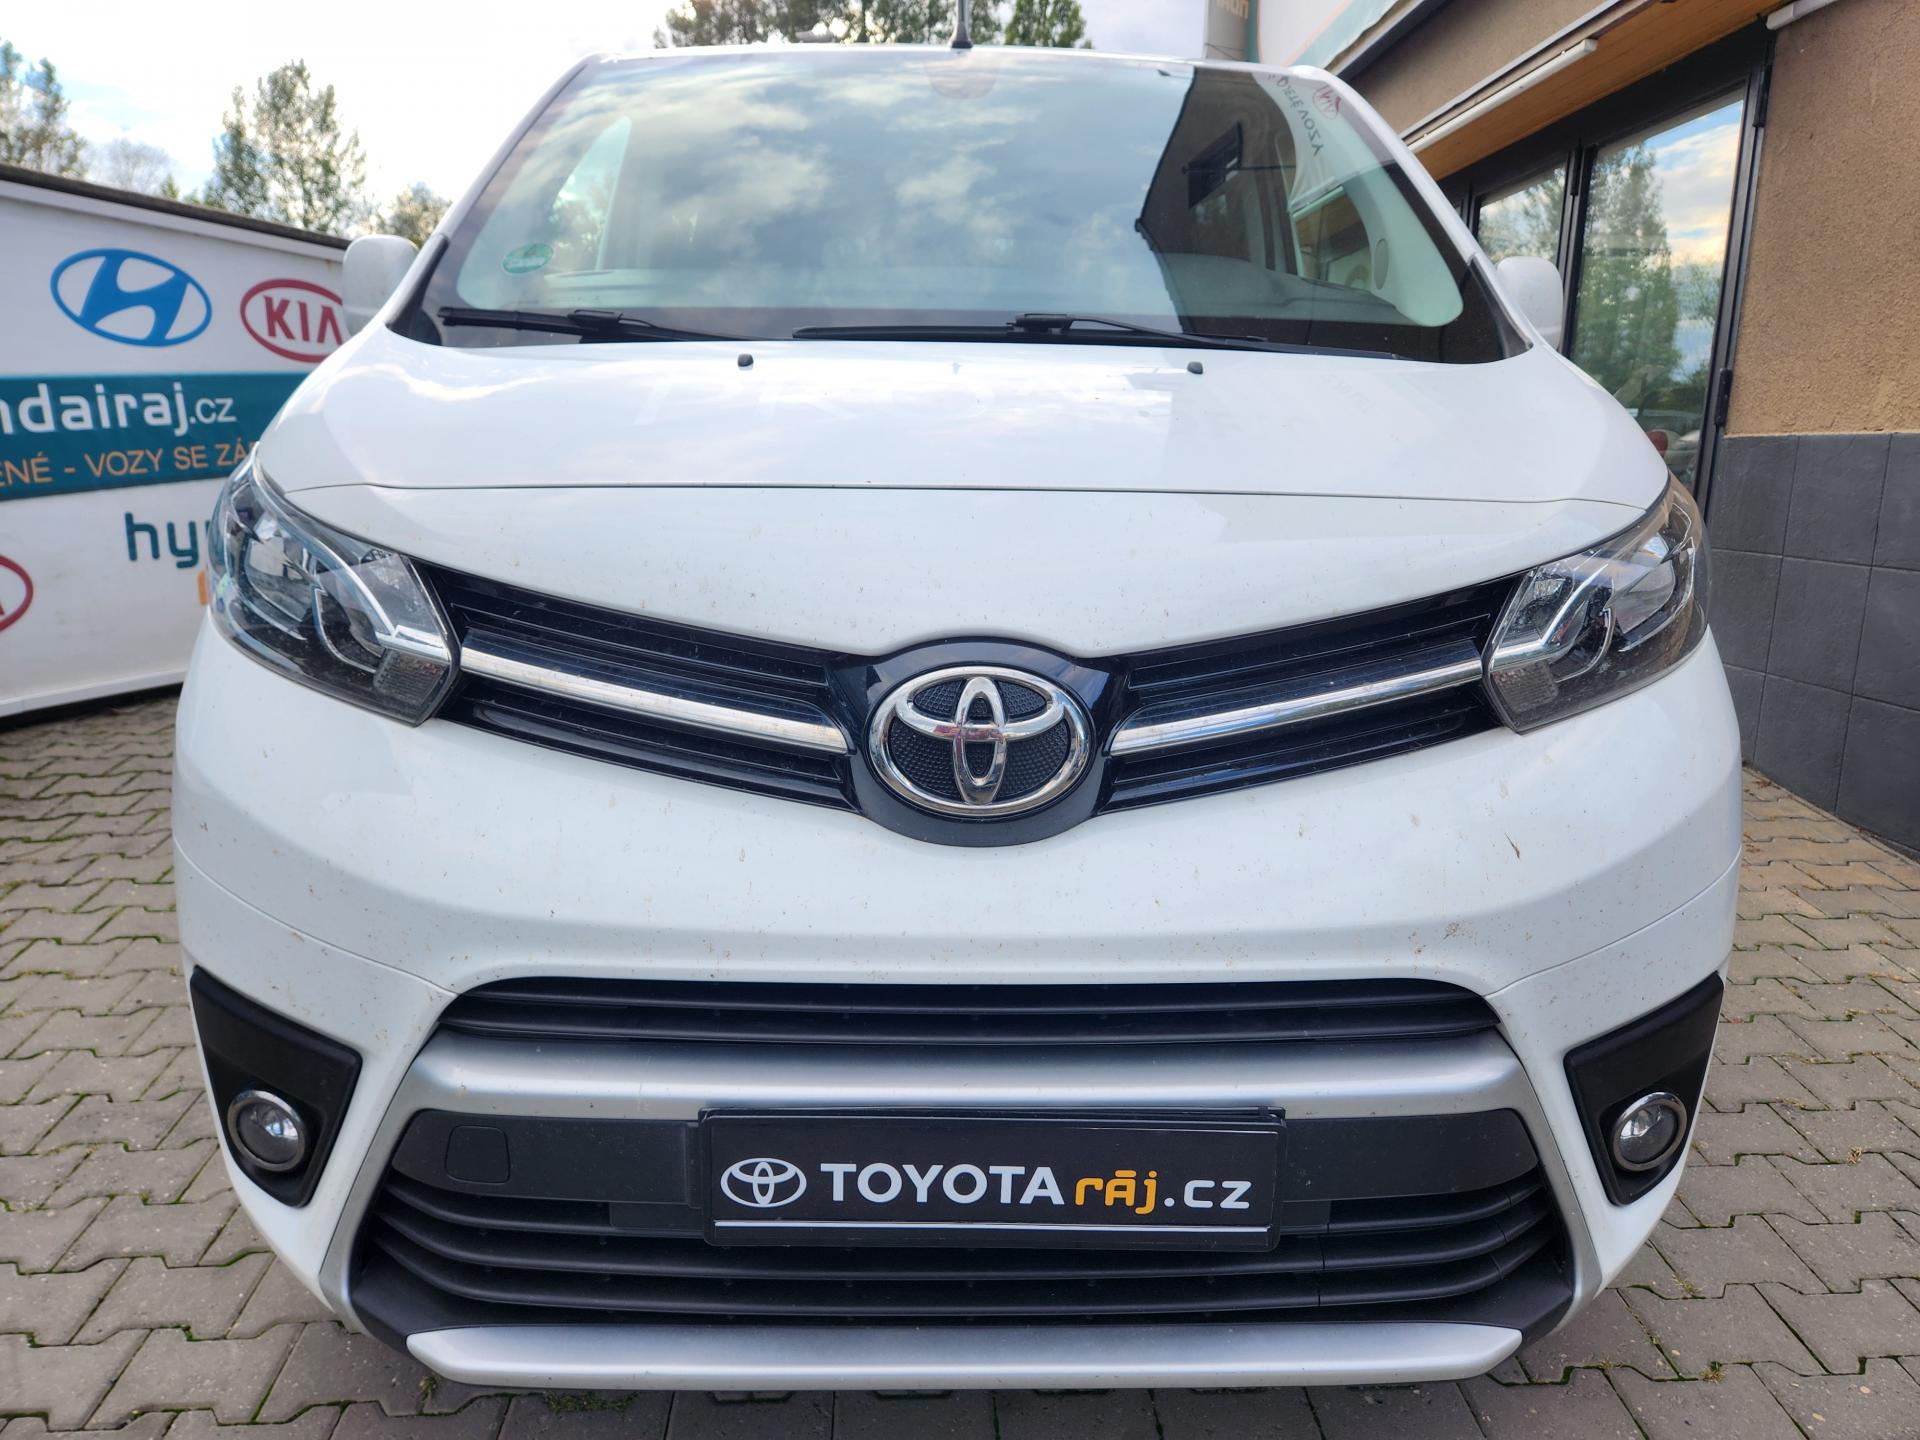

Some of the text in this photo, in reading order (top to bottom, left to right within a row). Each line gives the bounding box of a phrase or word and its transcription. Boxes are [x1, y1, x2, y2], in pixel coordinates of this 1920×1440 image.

[264, 294, 344, 346] KIA
[0, 451, 53, 488] NÉ
[84, 449, 163, 477] VOZY
[174, 445, 209, 470] SE
[215, 437, 256, 465] ZÁ
[125, 512, 209, 568] hy
[820, 1162, 1065, 1206] TOYOTA
